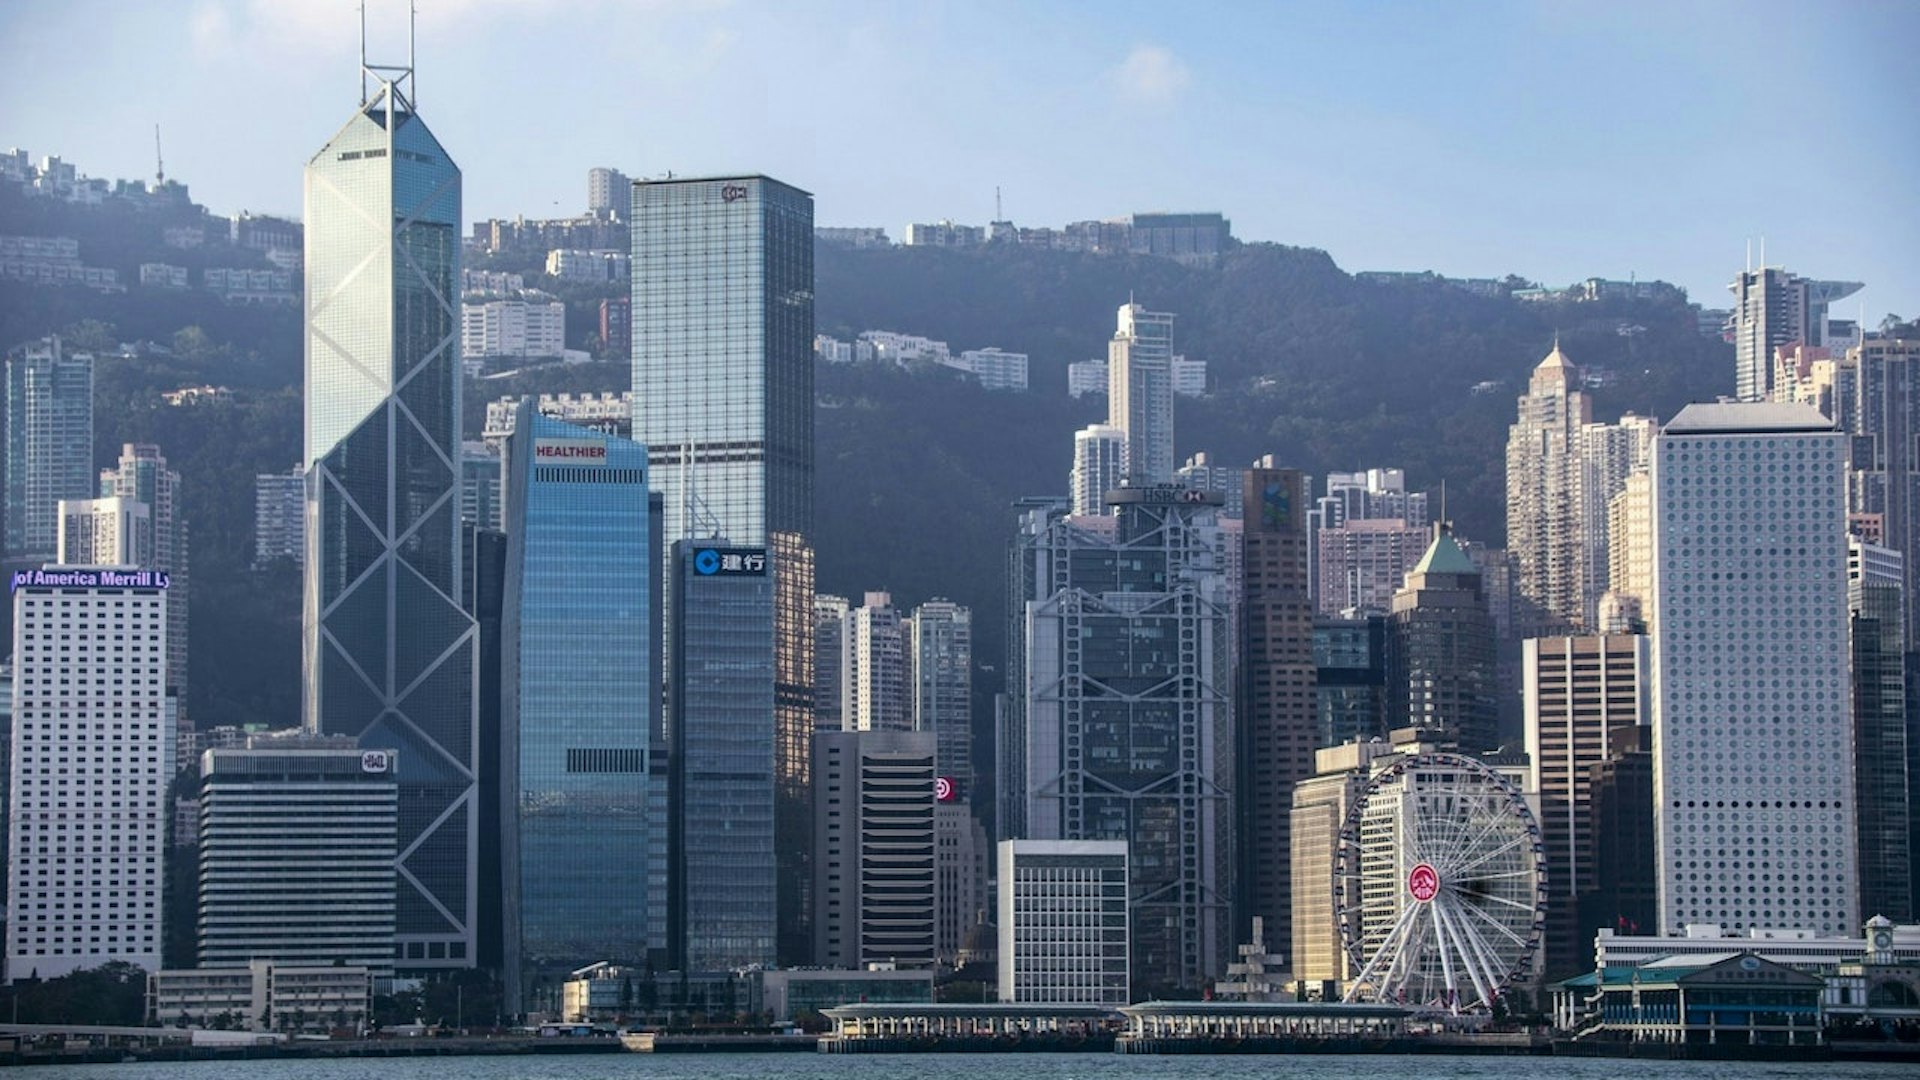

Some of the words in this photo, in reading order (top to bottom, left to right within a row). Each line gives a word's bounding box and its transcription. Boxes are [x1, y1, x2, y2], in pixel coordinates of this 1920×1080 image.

[536, 446, 606, 458] HEALTHIER
[1143, 488, 1181, 502] HSBC
[722, 554, 765, 571] 建行
[17, 571, 33, 585] of
[34, 571, 97, 586] America
[101, 571, 150, 586] Merrill
